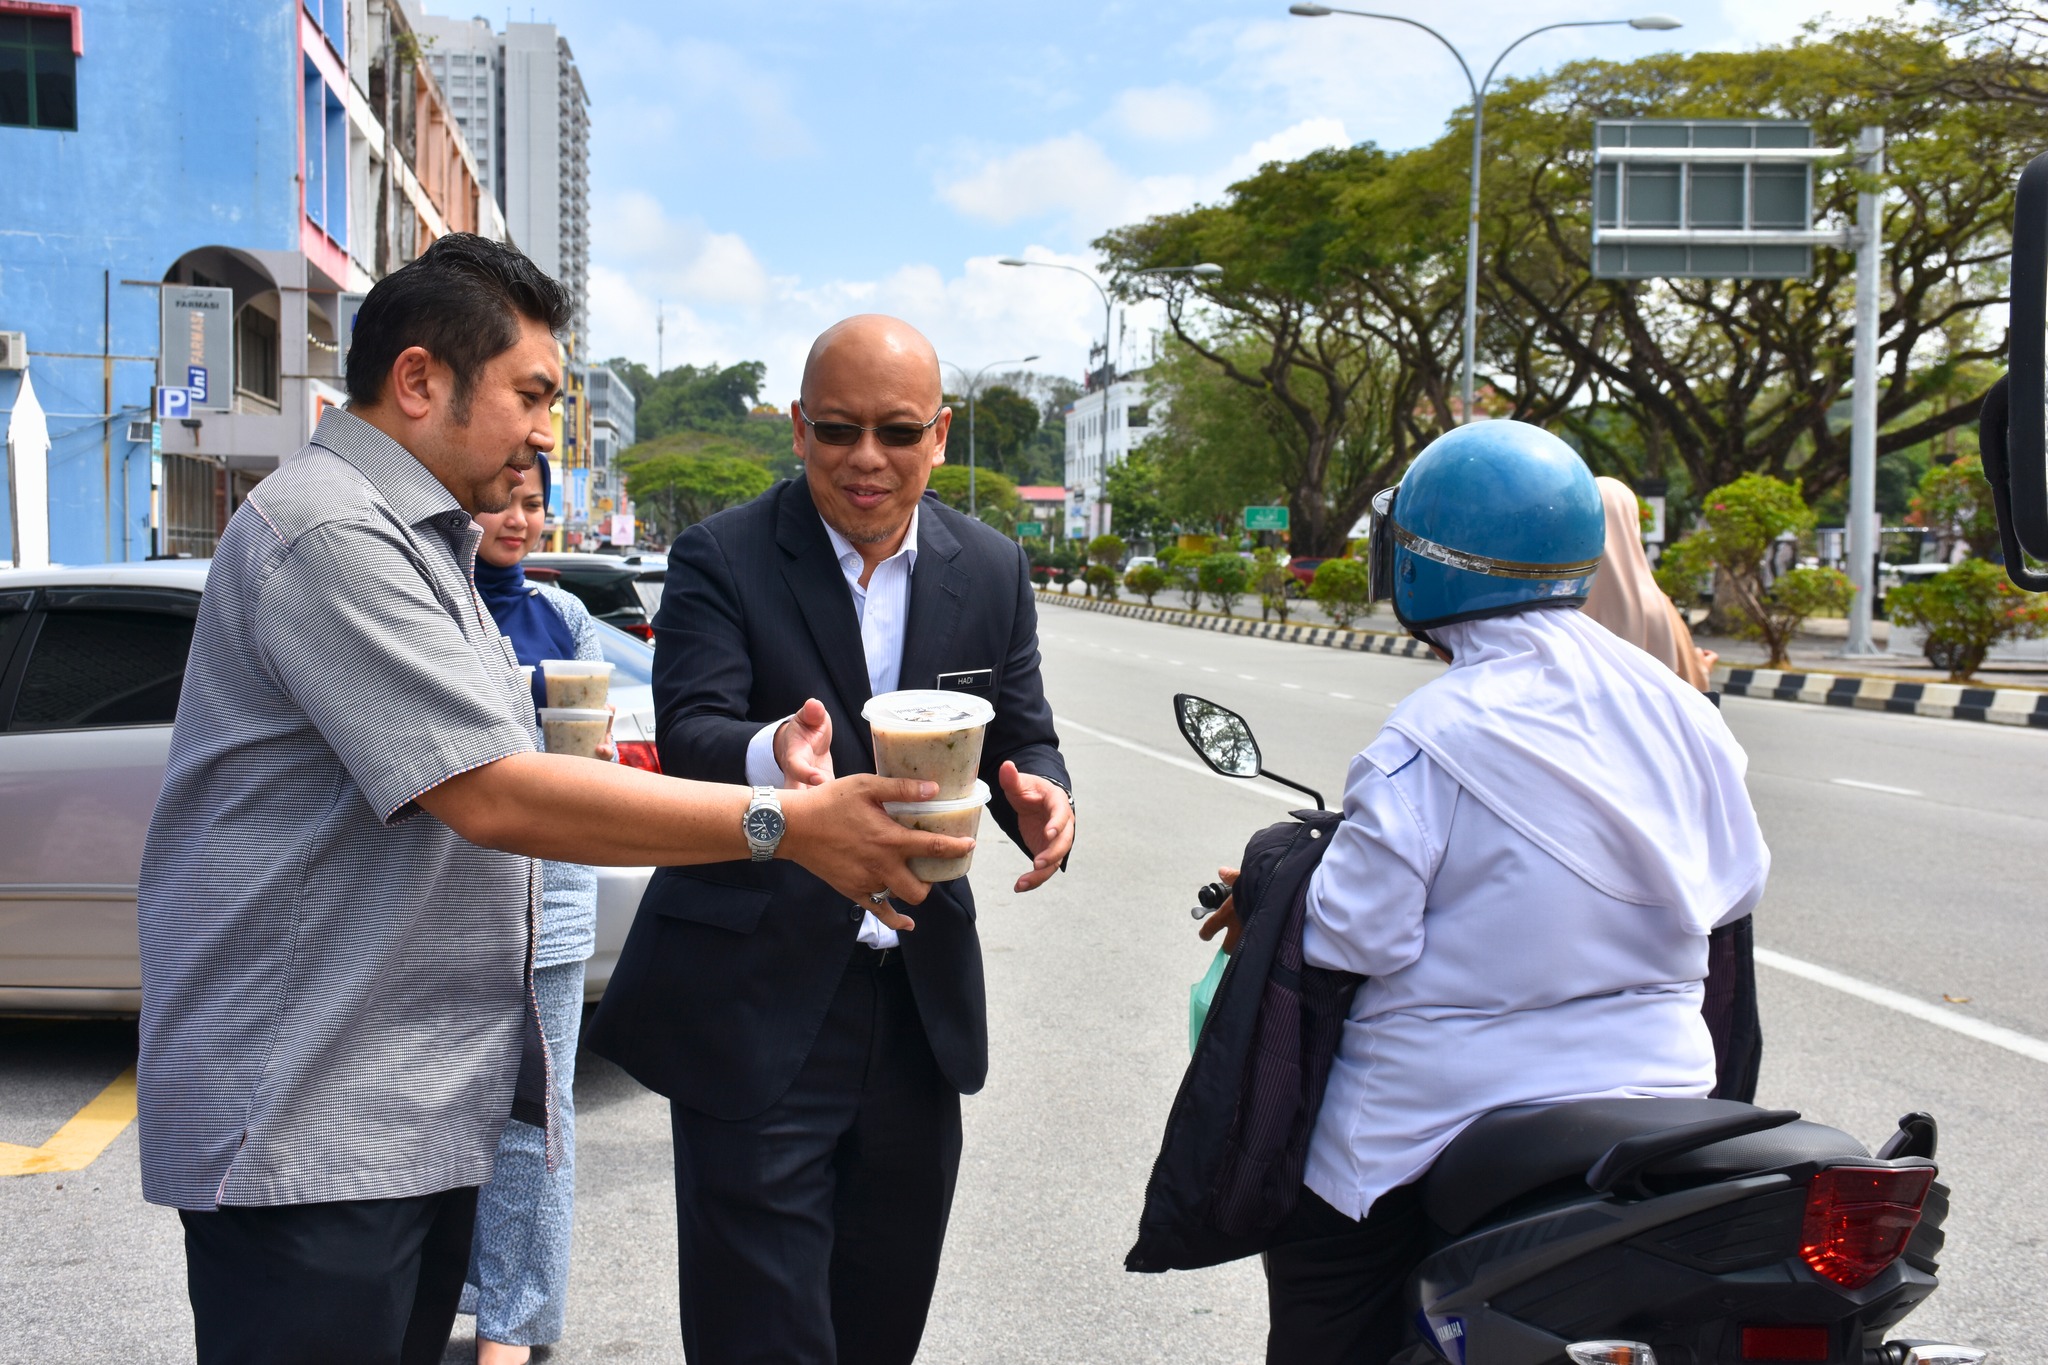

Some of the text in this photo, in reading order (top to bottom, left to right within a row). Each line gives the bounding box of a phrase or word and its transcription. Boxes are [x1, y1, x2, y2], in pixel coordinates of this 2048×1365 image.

[175, 301, 220, 309] FARMASI
[190, 311, 206, 400] Uni FARMASI
[164, 390, 187, 417] P
[957, 676, 974, 685] HADI
[1436, 1320, 1464, 1343] YAMAHA
